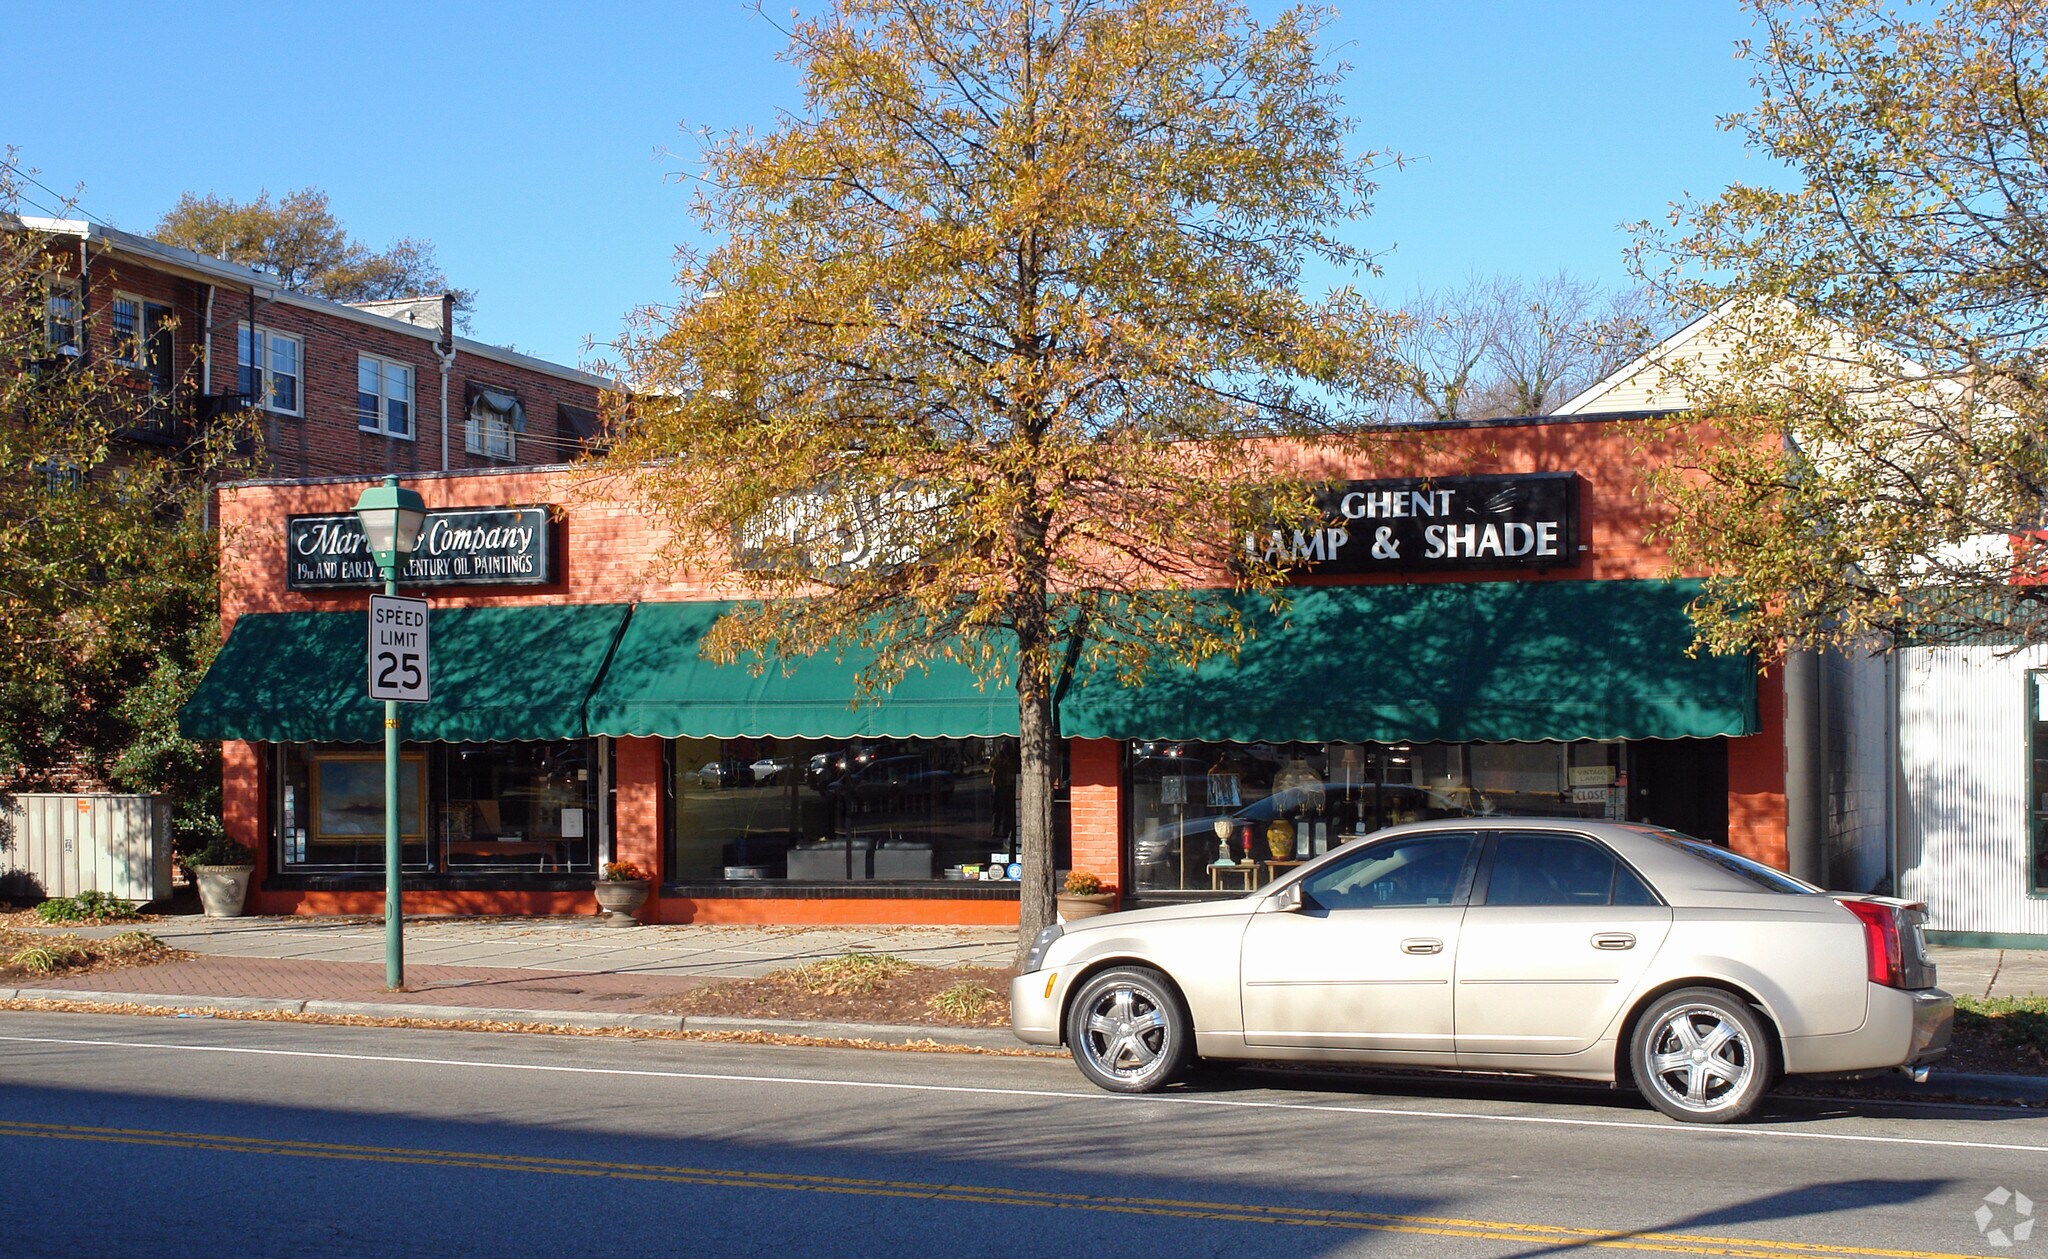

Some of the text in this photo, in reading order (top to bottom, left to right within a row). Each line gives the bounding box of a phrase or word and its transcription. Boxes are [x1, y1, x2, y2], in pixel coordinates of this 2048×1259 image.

[1341, 489, 1456, 520] GHENT
[429, 519, 533, 556] Company
[1371, 526, 1401, 560] &
[1424, 521, 1558, 559] SHADE
[316, 561, 338, 579] AND
[342, 560, 374, 578] EARLY
[454, 557, 471, 575] OIL
[475, 554, 533, 574] PAINTINGS
[376, 608, 423, 626] SPEED
[380, 630, 418, 647] LIMIT
[377, 652, 422, 690] 25
